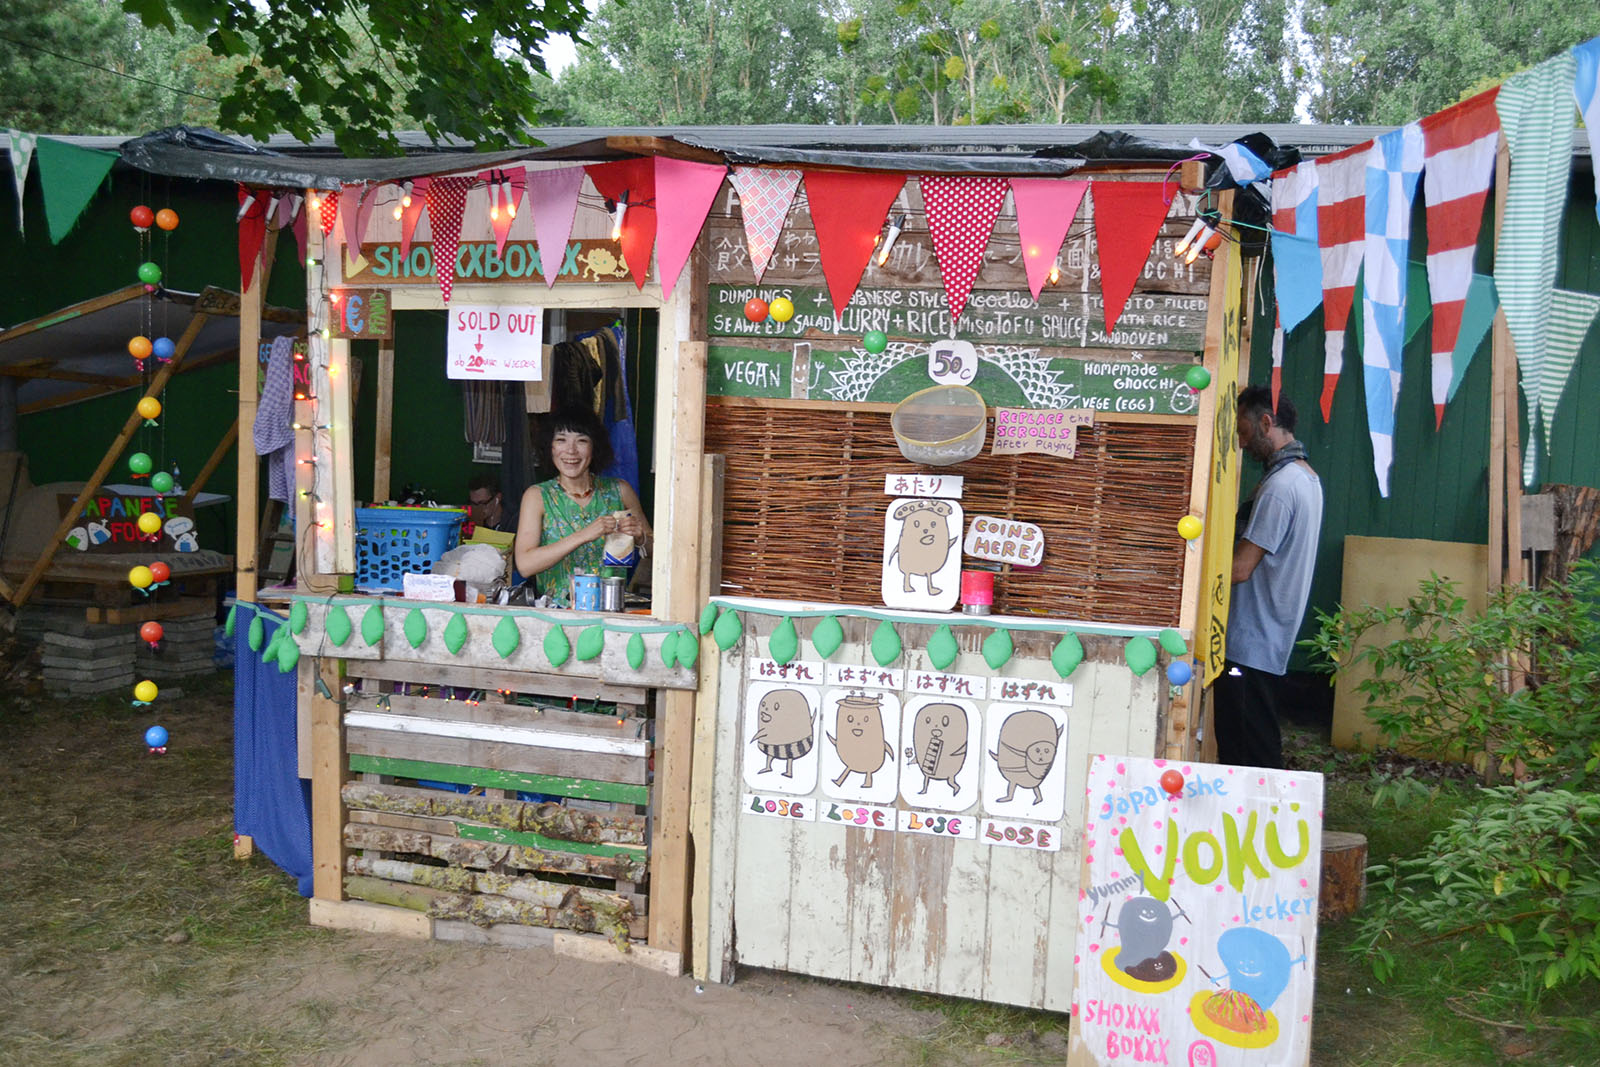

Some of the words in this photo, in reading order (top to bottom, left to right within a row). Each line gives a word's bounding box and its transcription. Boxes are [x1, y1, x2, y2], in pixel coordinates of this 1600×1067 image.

[1164, 298, 1207, 310] FILLED
[458, 311, 500, 331] SOLD
[507, 313, 536, 335] OUT
[714, 314, 785, 335] SEAWEED
[793, 314, 832, 335] SALAD
[840, 307, 890, 333] CURRY
[907, 310, 950, 336] RICE
[1042, 314, 1082, 339] SAUCE
[1153, 314, 1186, 328] RICE
[724, 360, 781, 388] VEGAN
[1083, 397, 1110, 410] VEGE
[1000, 411, 1064, 425] REPLACE
[1069, 415, 1090, 424] the
[997, 425, 1071, 439] SCROLLS
[894, 476, 942, 494] あたり
[975, 519, 1037, 542] COINS
[973, 537, 1042, 563] HERE!
[760, 662, 813, 680] はずれ
[838, 668, 894, 687] はずれ
[916, 674, 973, 696] はずれ
[1001, 681, 1056, 700] はずれ
[750, 796, 804, 818] LOSE
[827, 803, 885, 827] LOSE
[908, 813, 962, 835] LOSE
[985, 823, 1052, 847] LOSE
[1119, 802, 1310, 902] VOKÜ
[1243, 893, 1315, 924] lecker
[1085, 1000, 1160, 1035] SHOXXX
[1106, 1031, 1170, 1065] BOXXX
